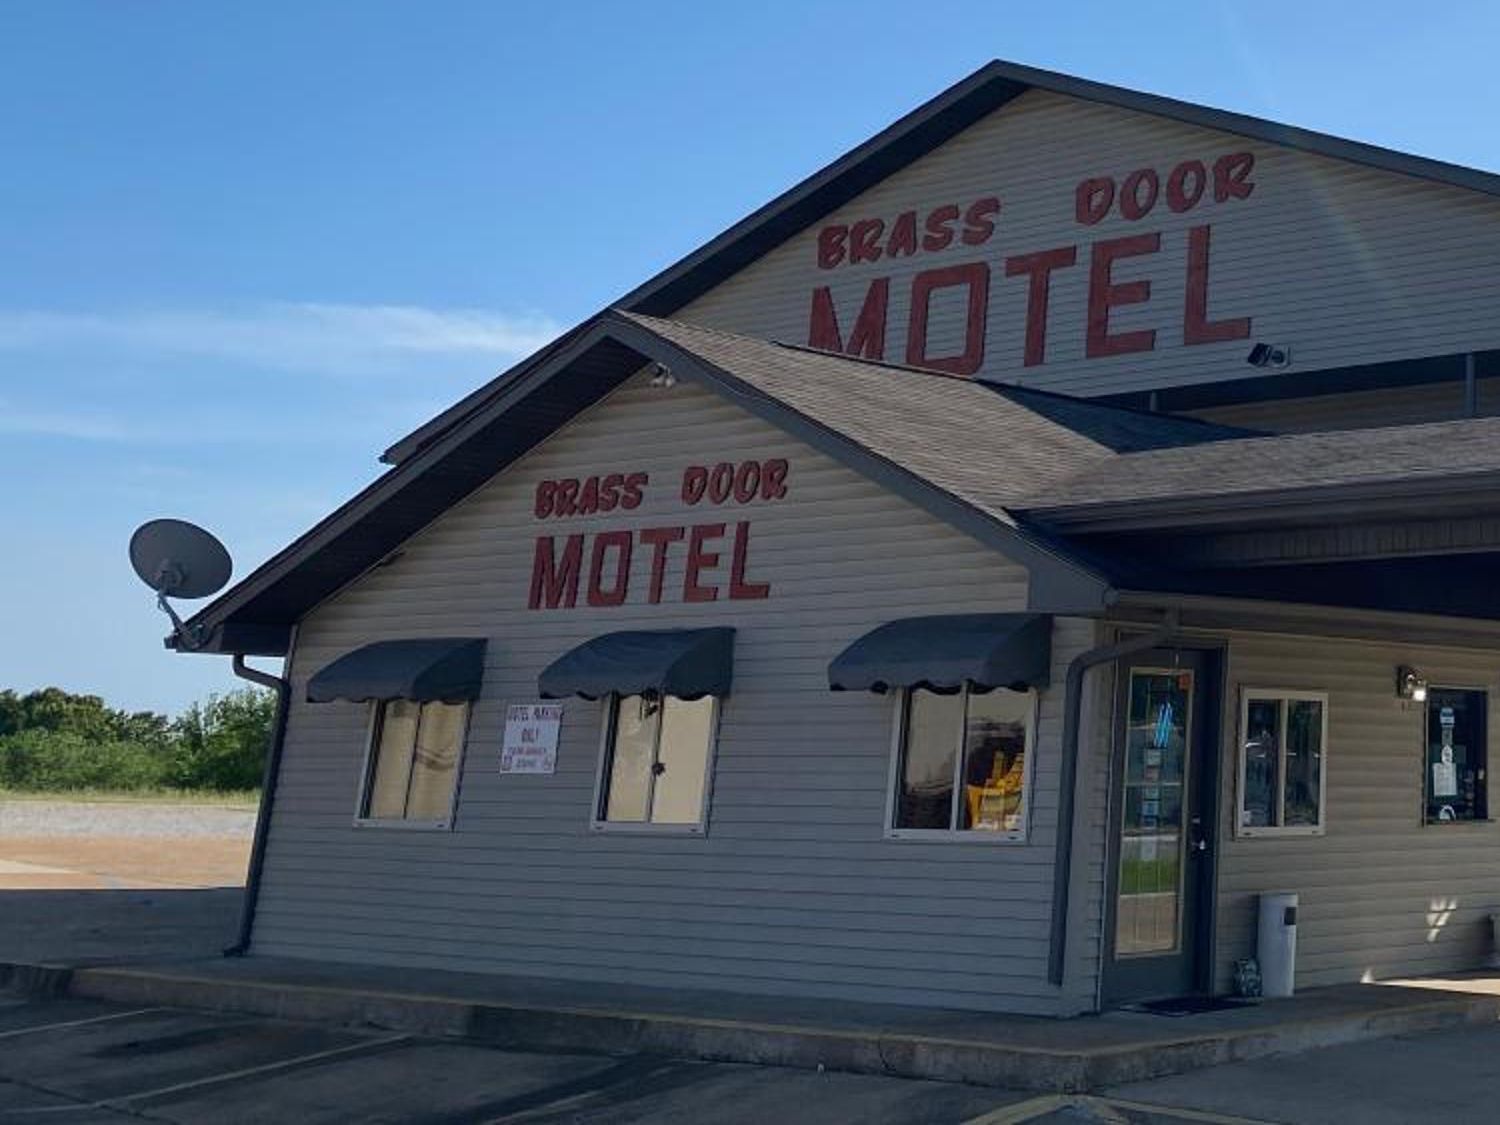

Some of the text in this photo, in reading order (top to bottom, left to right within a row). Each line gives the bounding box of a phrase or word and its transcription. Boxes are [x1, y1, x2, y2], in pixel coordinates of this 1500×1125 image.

[816, 151, 1255, 270] BRASS DOOR
[808, 223, 1253, 375] MOTEL
[533, 458, 790, 520] BRASS DOOR
[527, 520, 772, 611] MOTEL
